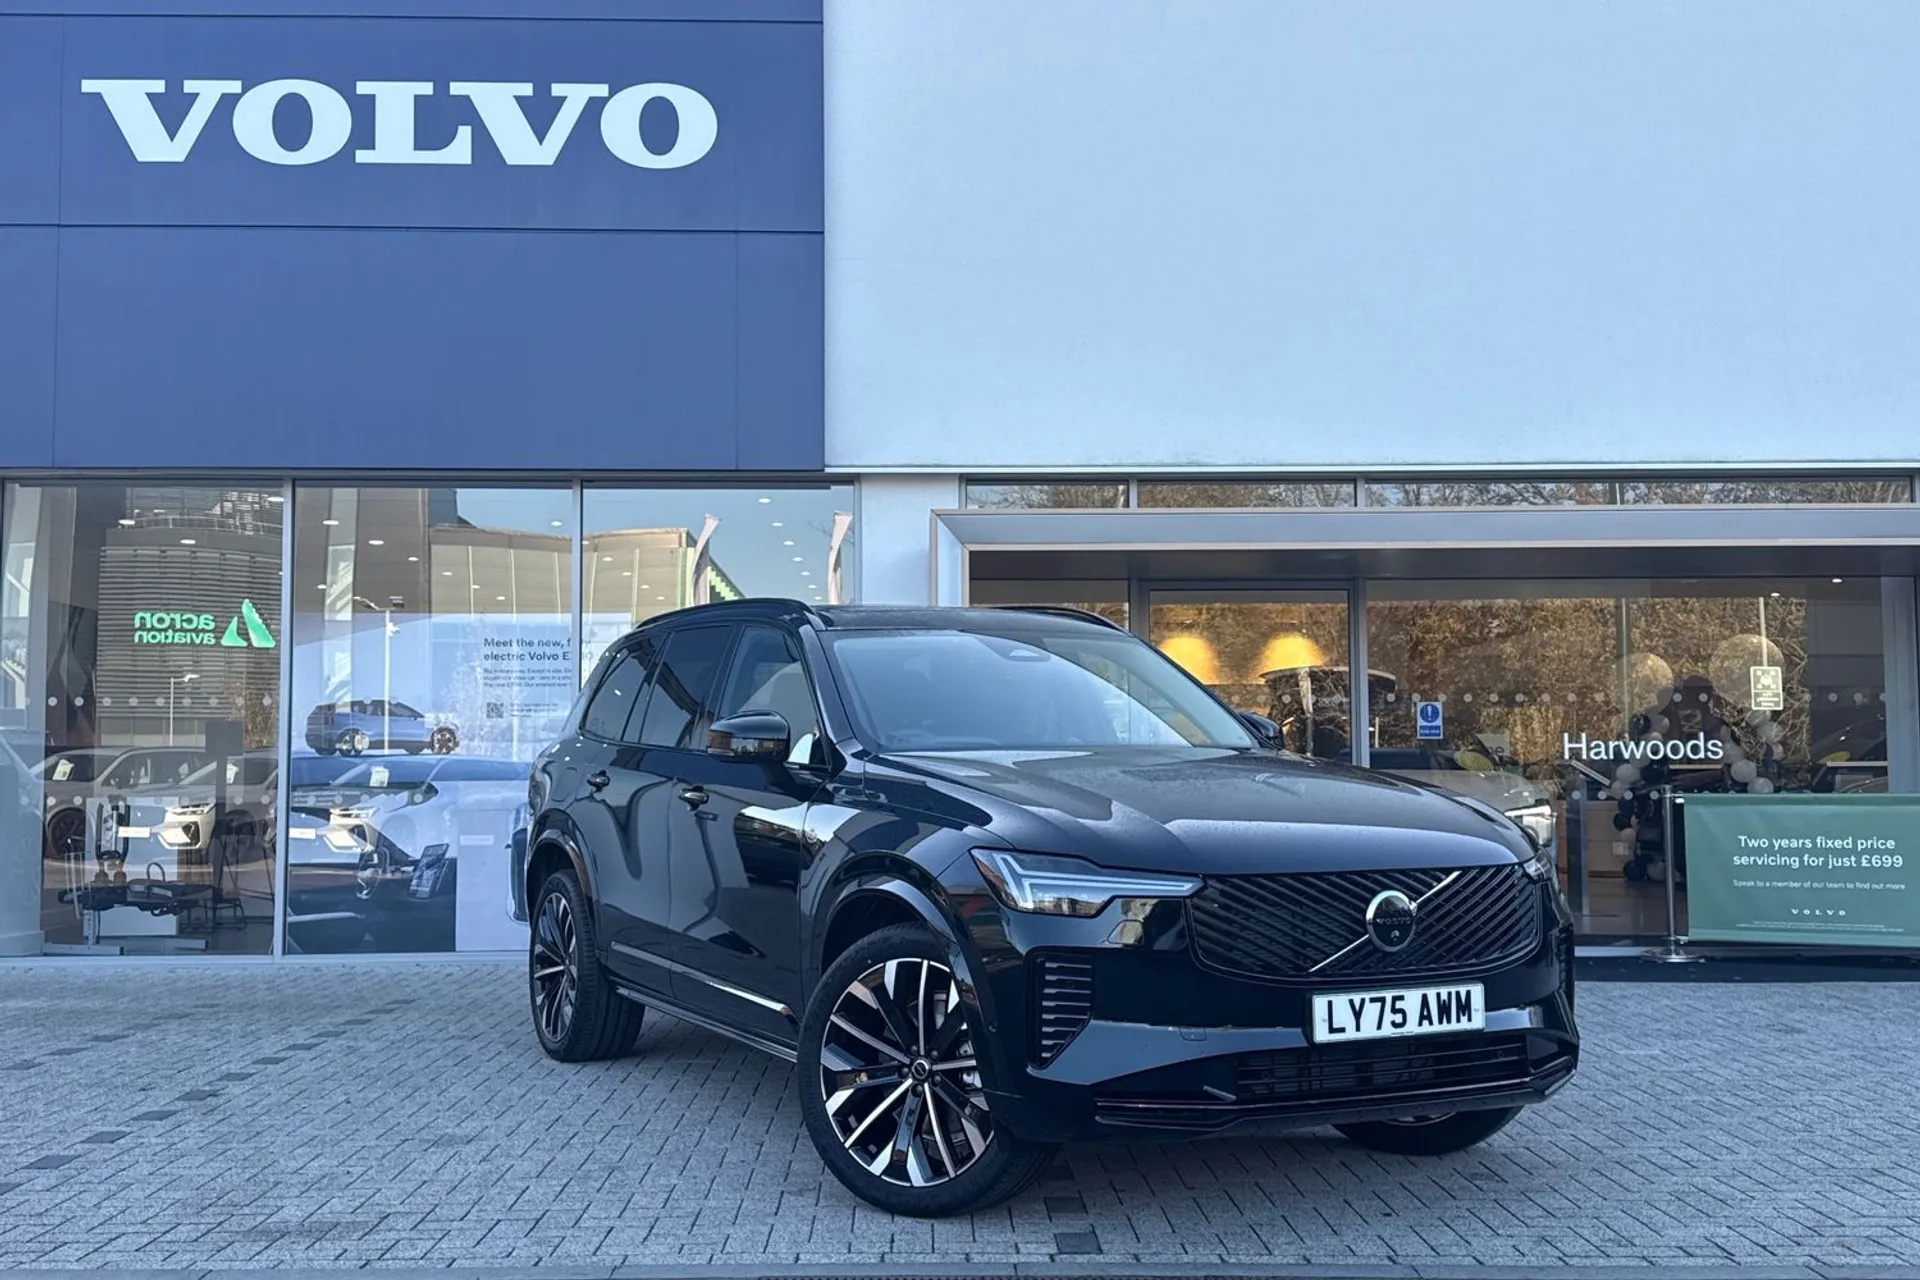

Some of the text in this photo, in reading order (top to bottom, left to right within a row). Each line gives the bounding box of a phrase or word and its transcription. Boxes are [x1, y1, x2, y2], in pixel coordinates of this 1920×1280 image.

[81, 79, 718, 169] VOLVO
[484, 637, 513, 648] Meet
[517, 637, 535, 648] the
[484, 651, 525, 662] electric
[529, 651, 559, 662] Volvo
[1564, 732, 1724, 762] Harwoods
[1738, 834, 1896, 852] Two years fixed price
[1733, 854, 1904, 869] servicing for just £699
[1733, 879, 1755, 888] Speak
[1771, 880, 1802, 888] member
[1855, 882, 1870, 890] find
[1871, 882, 1885, 890] out
[1790, 907, 1846, 916] VOLVO
[1326, 989, 1473, 1035] LY75 AWM
